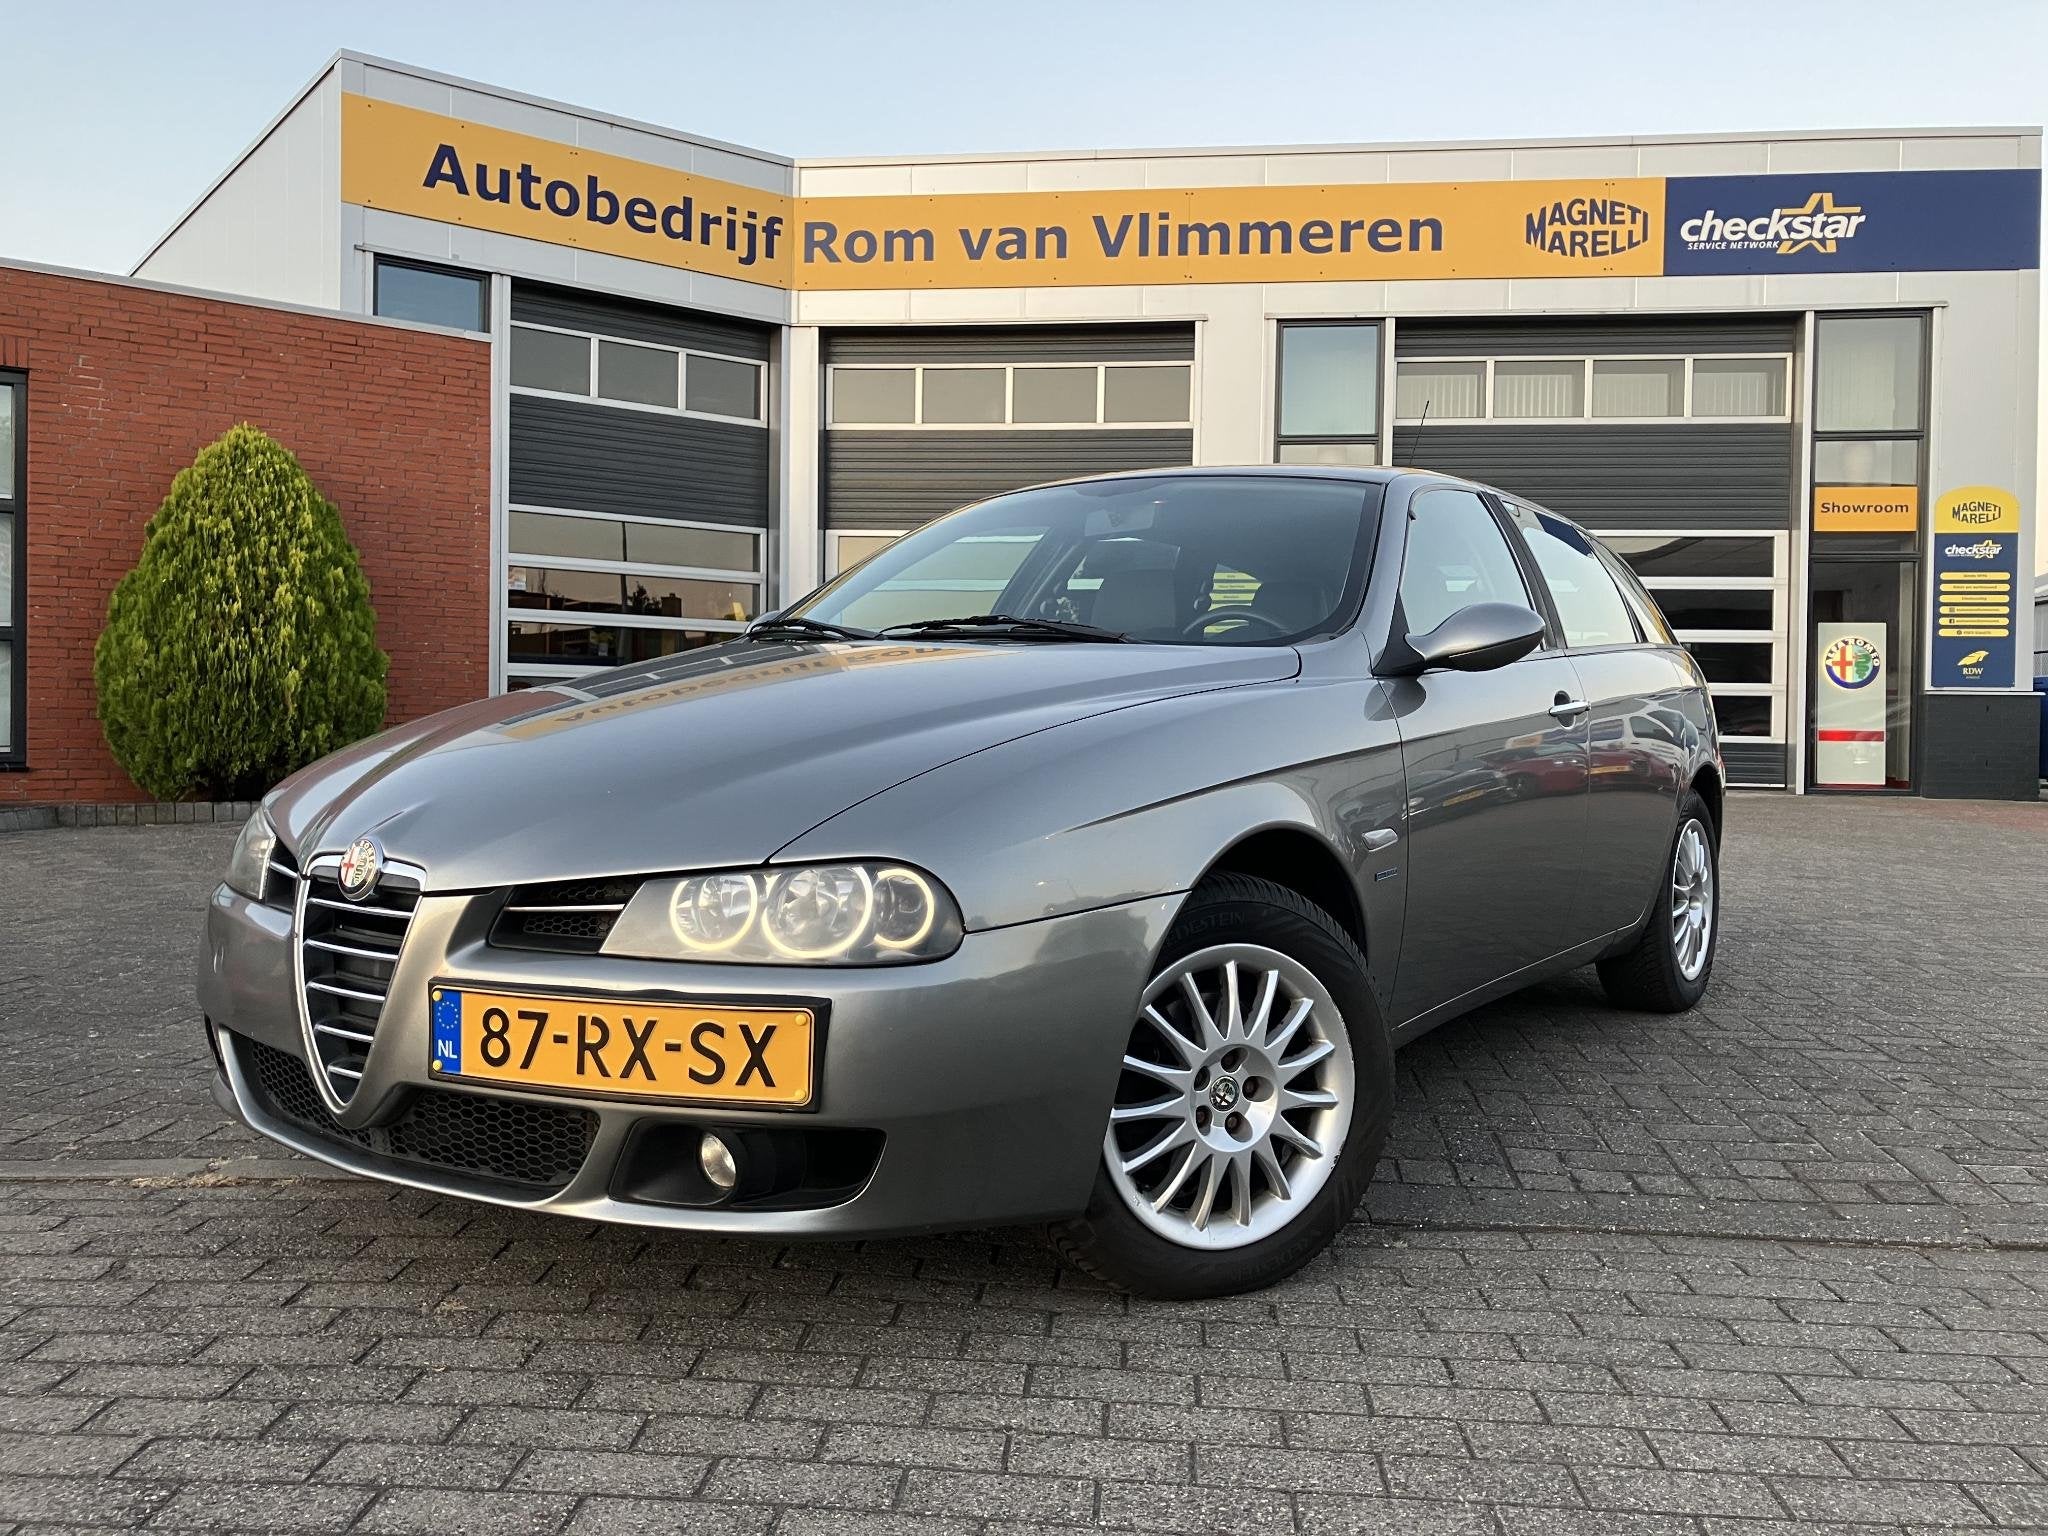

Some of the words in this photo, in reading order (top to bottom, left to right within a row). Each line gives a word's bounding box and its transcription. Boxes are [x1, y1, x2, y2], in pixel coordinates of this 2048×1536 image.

[422, 143, 784, 266] Autobedrijf
[802, 220, 935, 264] Rom
[959, 225, 1068, 261] van
[1092, 212, 1444, 259] Vlimmeren
[1525, 198, 1649, 236] MAGNETI
[1680, 208, 1867, 243] checkstar
[1525, 221, 1649, 258] MARELLI
[1687, 240, 1727, 250] SERVICE
[1729, 240, 1780, 250] NETWORK
[1820, 502, 1909, 513] Showroom
[1952, 501, 2001, 515] MAGNETI
[1952, 510, 2001, 524] MARELLI
[1944, 543, 2003, 555] checkstar
[1825, 641, 1847, 668] ALFA
[1847, 638, 1880, 667] ROMEO
[1962, 667, 1984, 675] RDW
[437, 1039, 458, 1059] NL
[480, 1007, 777, 1087] 87-RX-SX
